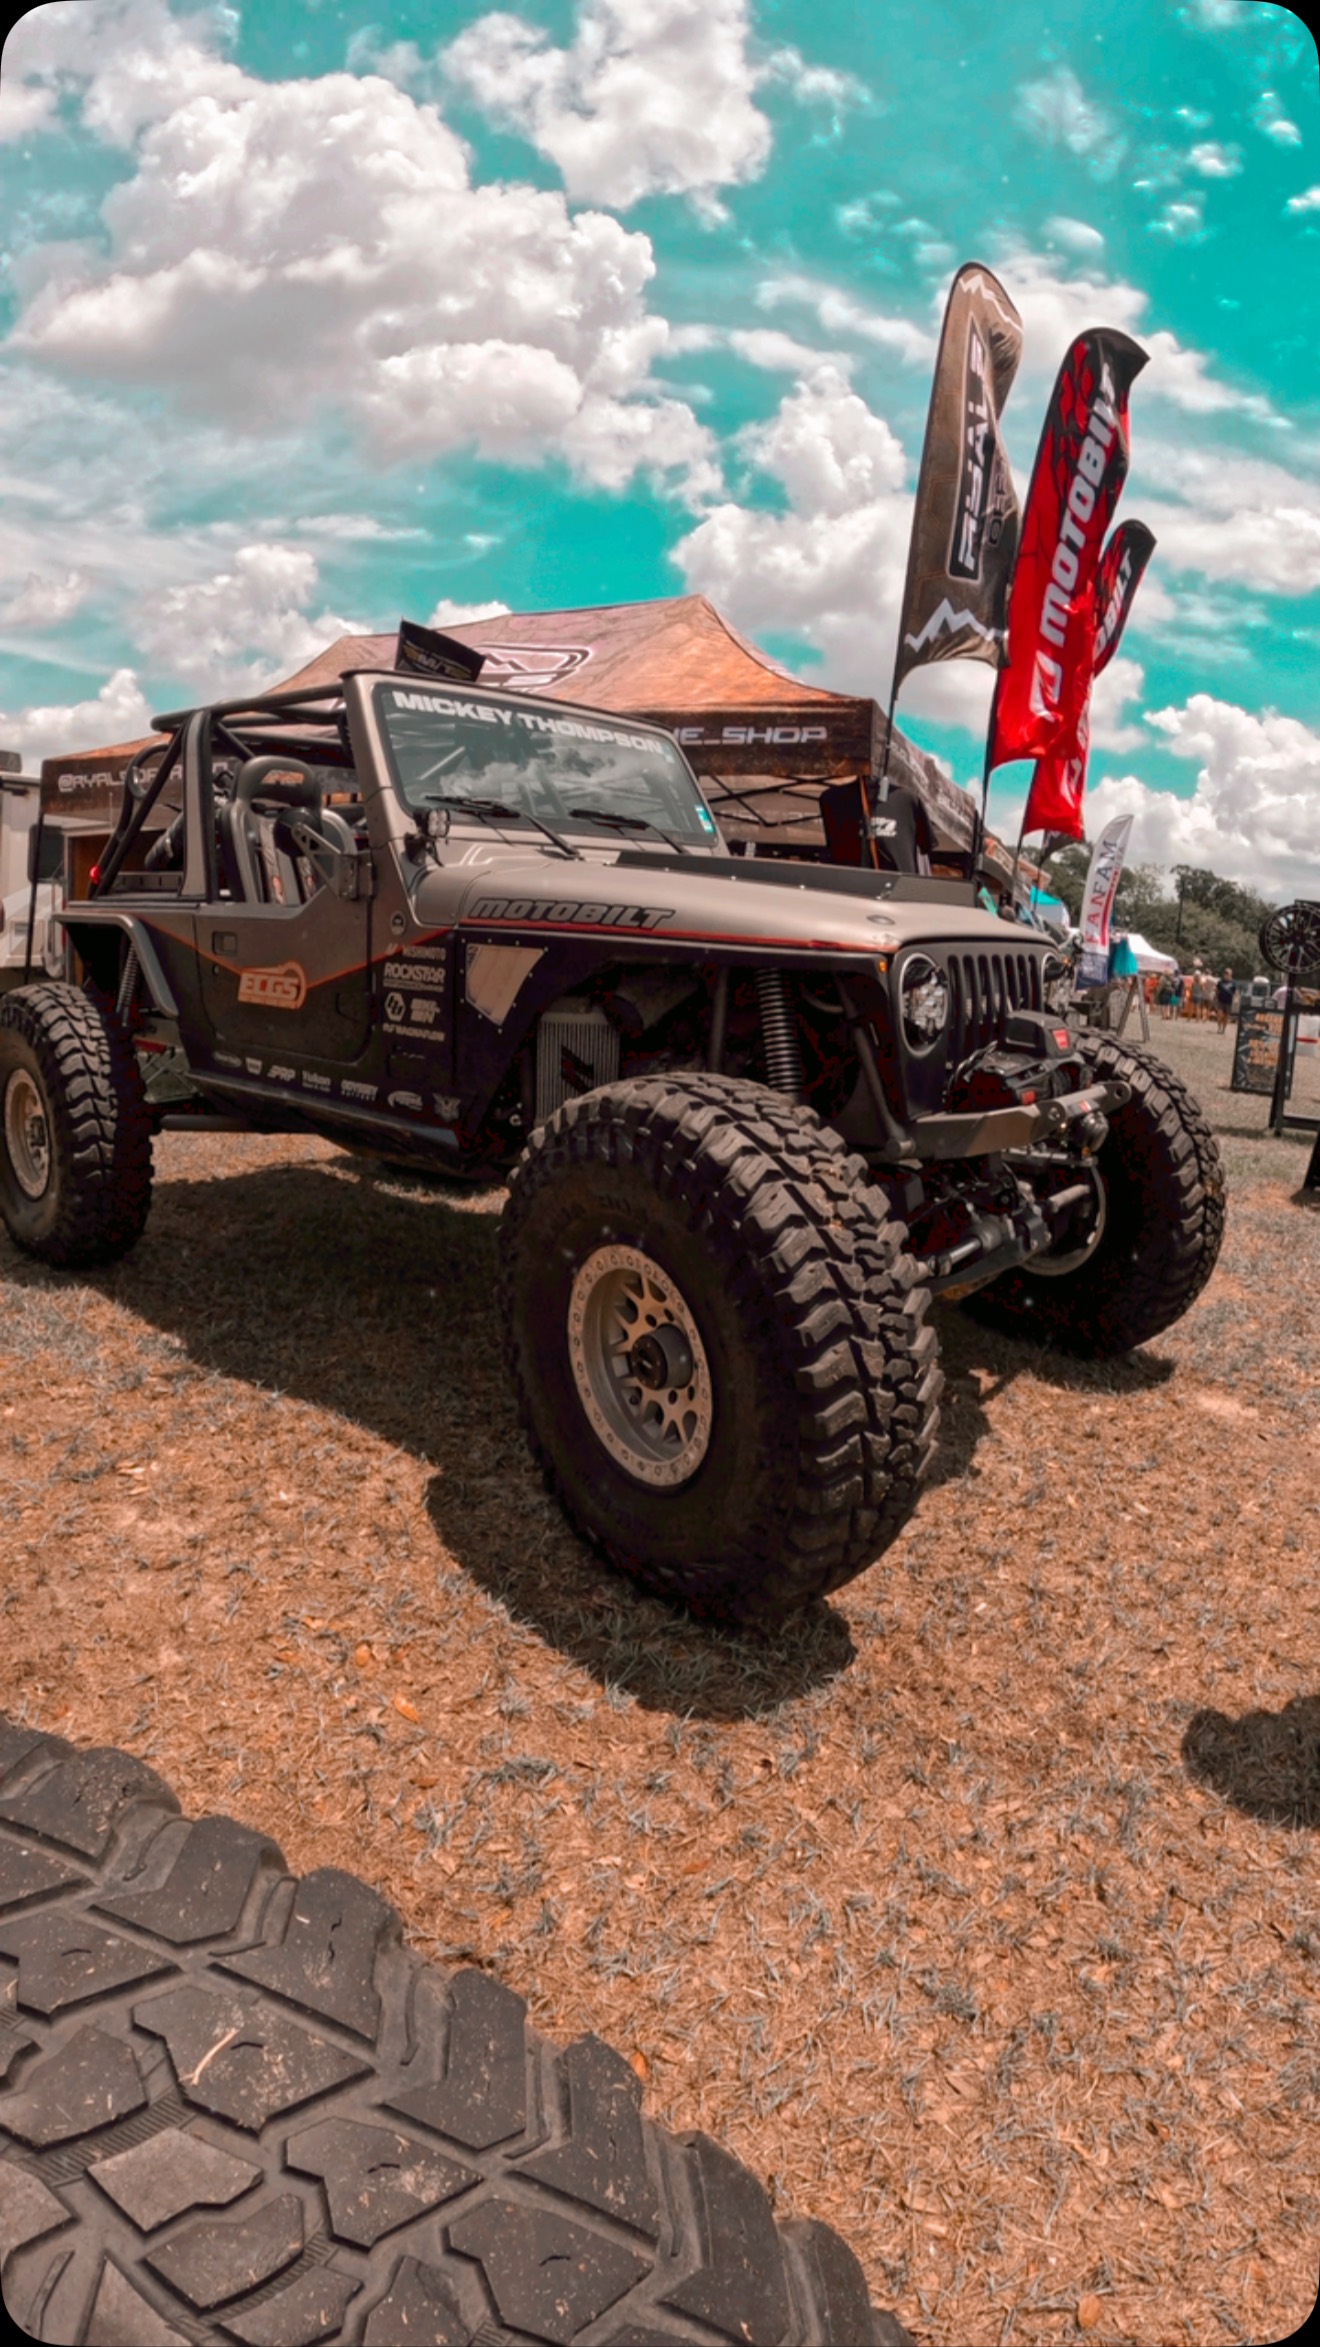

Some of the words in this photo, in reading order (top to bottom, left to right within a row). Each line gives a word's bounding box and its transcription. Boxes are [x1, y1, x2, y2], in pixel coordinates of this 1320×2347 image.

[1039, 363, 1116, 648] MOTOBILT
[392, 690, 512, 726] MICKEY
[517, 712, 663, 754] THOMPSON
[468, 897, 676, 930] MOTOBILT
[239, 972, 299, 1001] ECGS
[384, 961, 447, 984] ROCKSTAR
